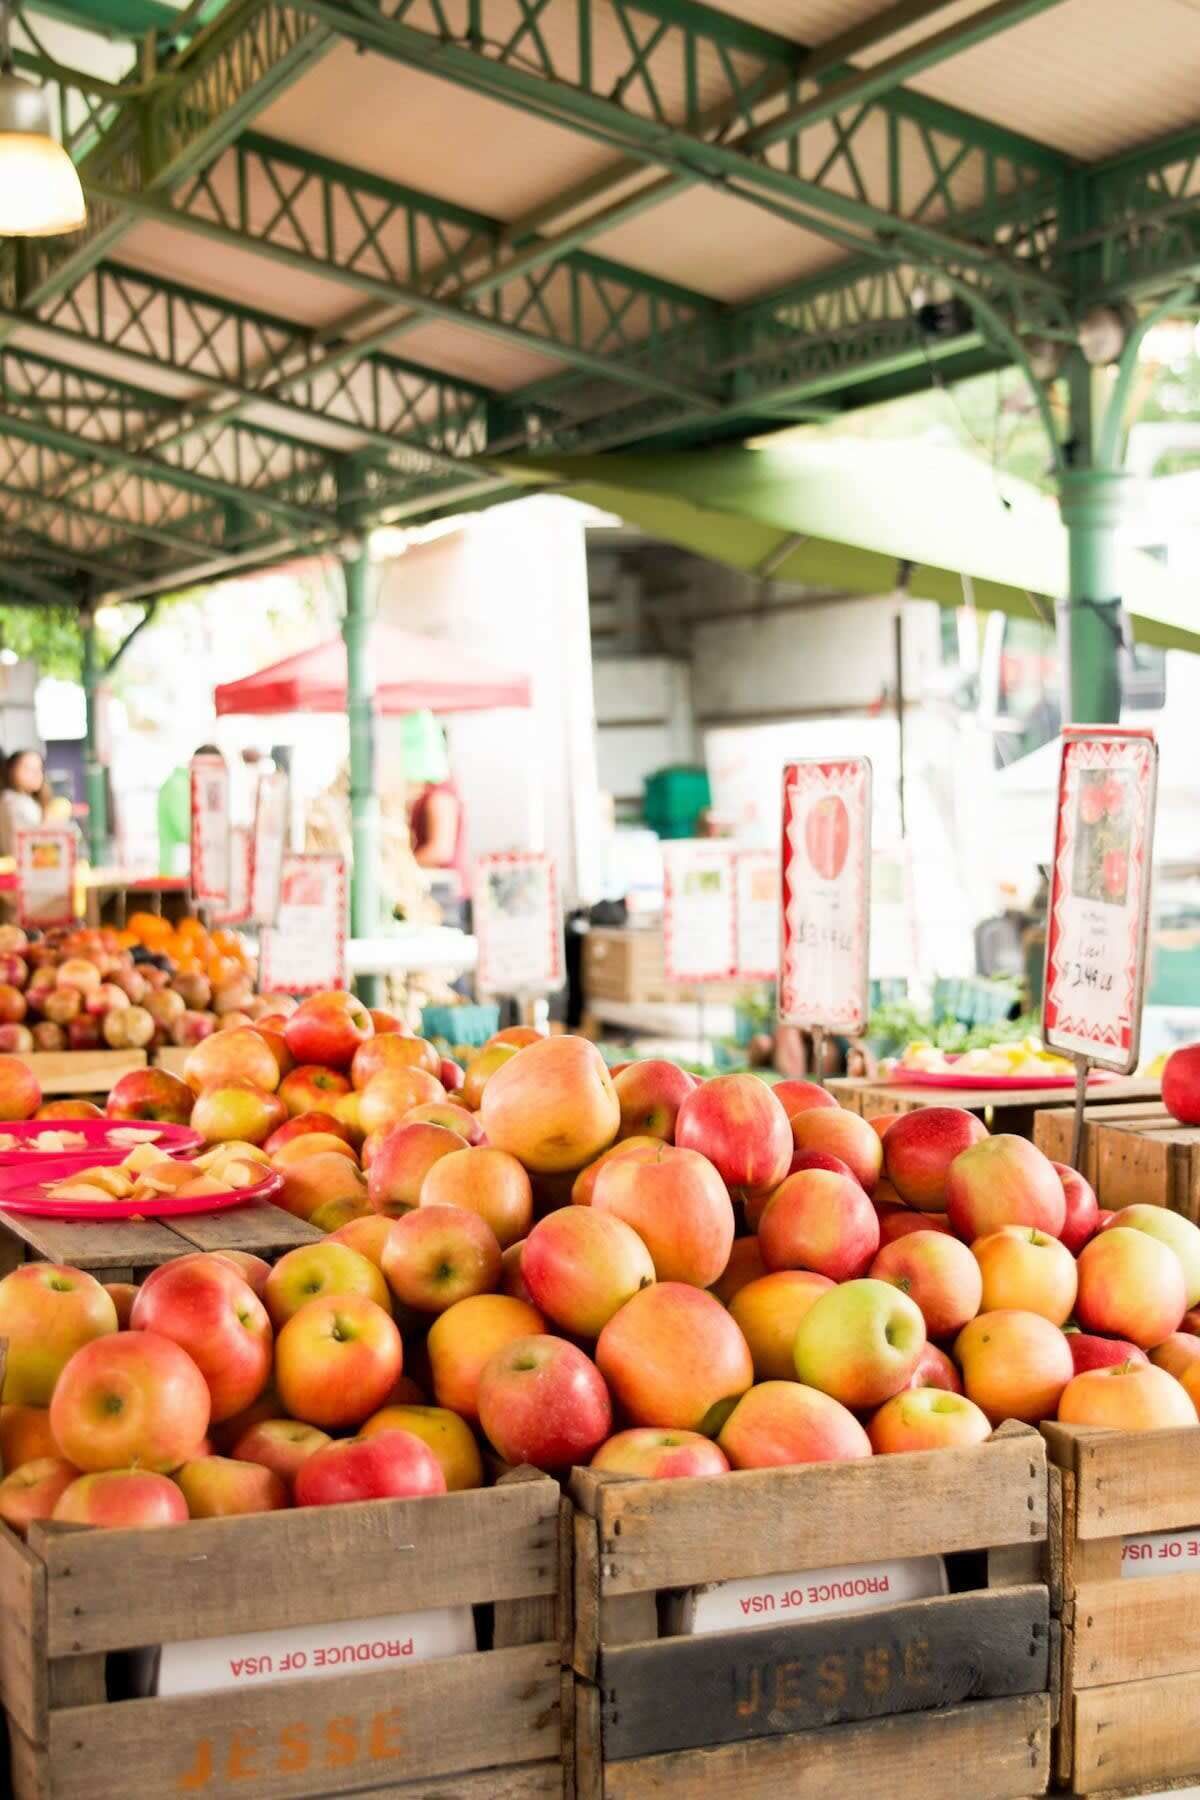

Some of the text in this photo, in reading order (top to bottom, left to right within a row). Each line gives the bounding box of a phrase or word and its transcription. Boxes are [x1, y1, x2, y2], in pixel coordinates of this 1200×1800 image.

[1158, 1542, 1182, 1558] OF
[739, 1575, 890, 1614] PRODUCE OF USA
[229, 1638, 414, 1677] PRODUCE OF USA
[735, 1638, 930, 1718] JESSE
[177, 1706, 405, 1789] JESSE
